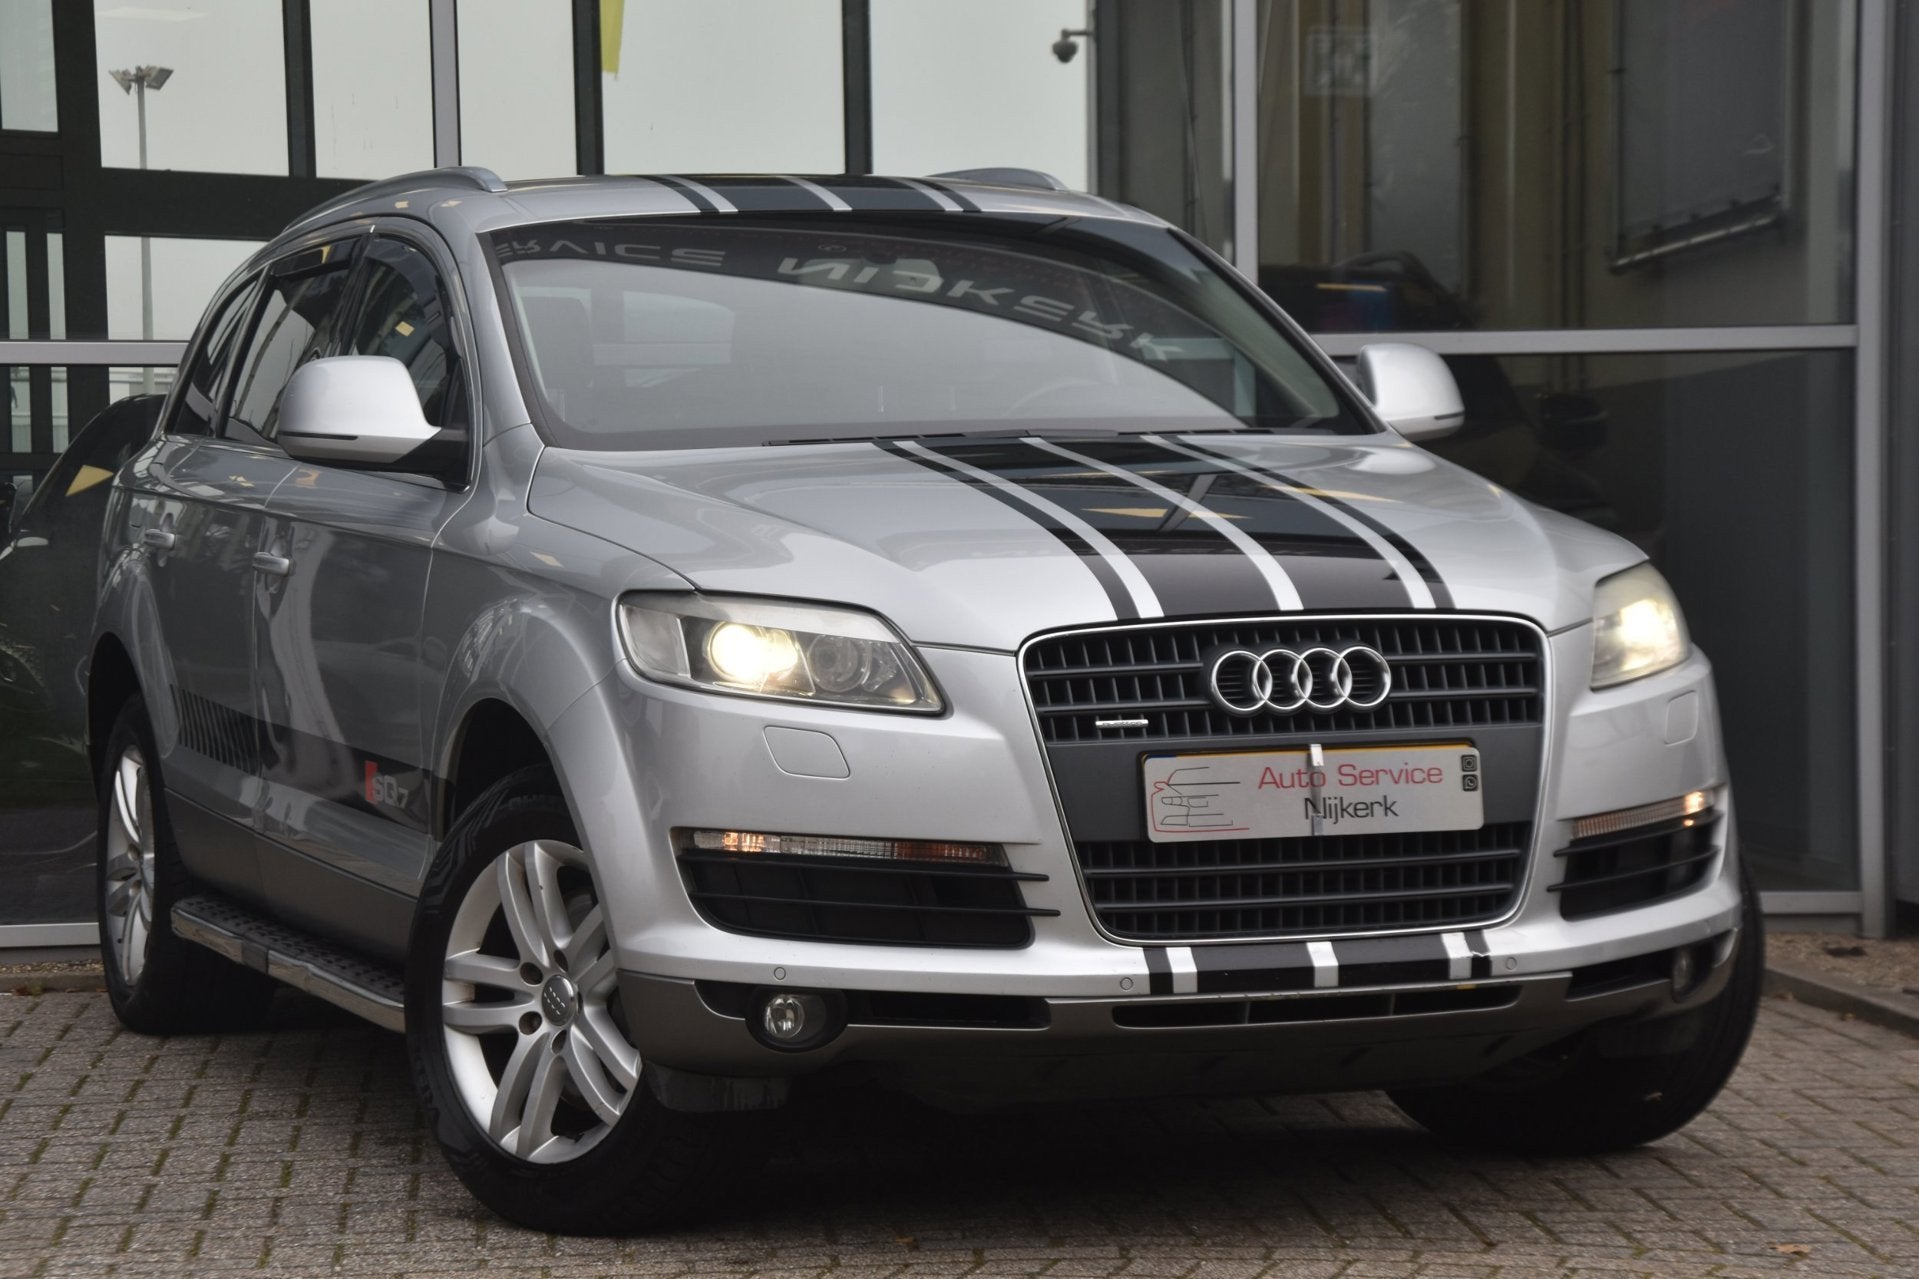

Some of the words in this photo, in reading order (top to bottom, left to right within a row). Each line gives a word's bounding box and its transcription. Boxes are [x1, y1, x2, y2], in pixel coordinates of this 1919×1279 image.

[1258, 767, 1326, 789] Auto
[1338, 763, 1443, 786] Service
[1304, 795, 1399, 824] Nijkerk
